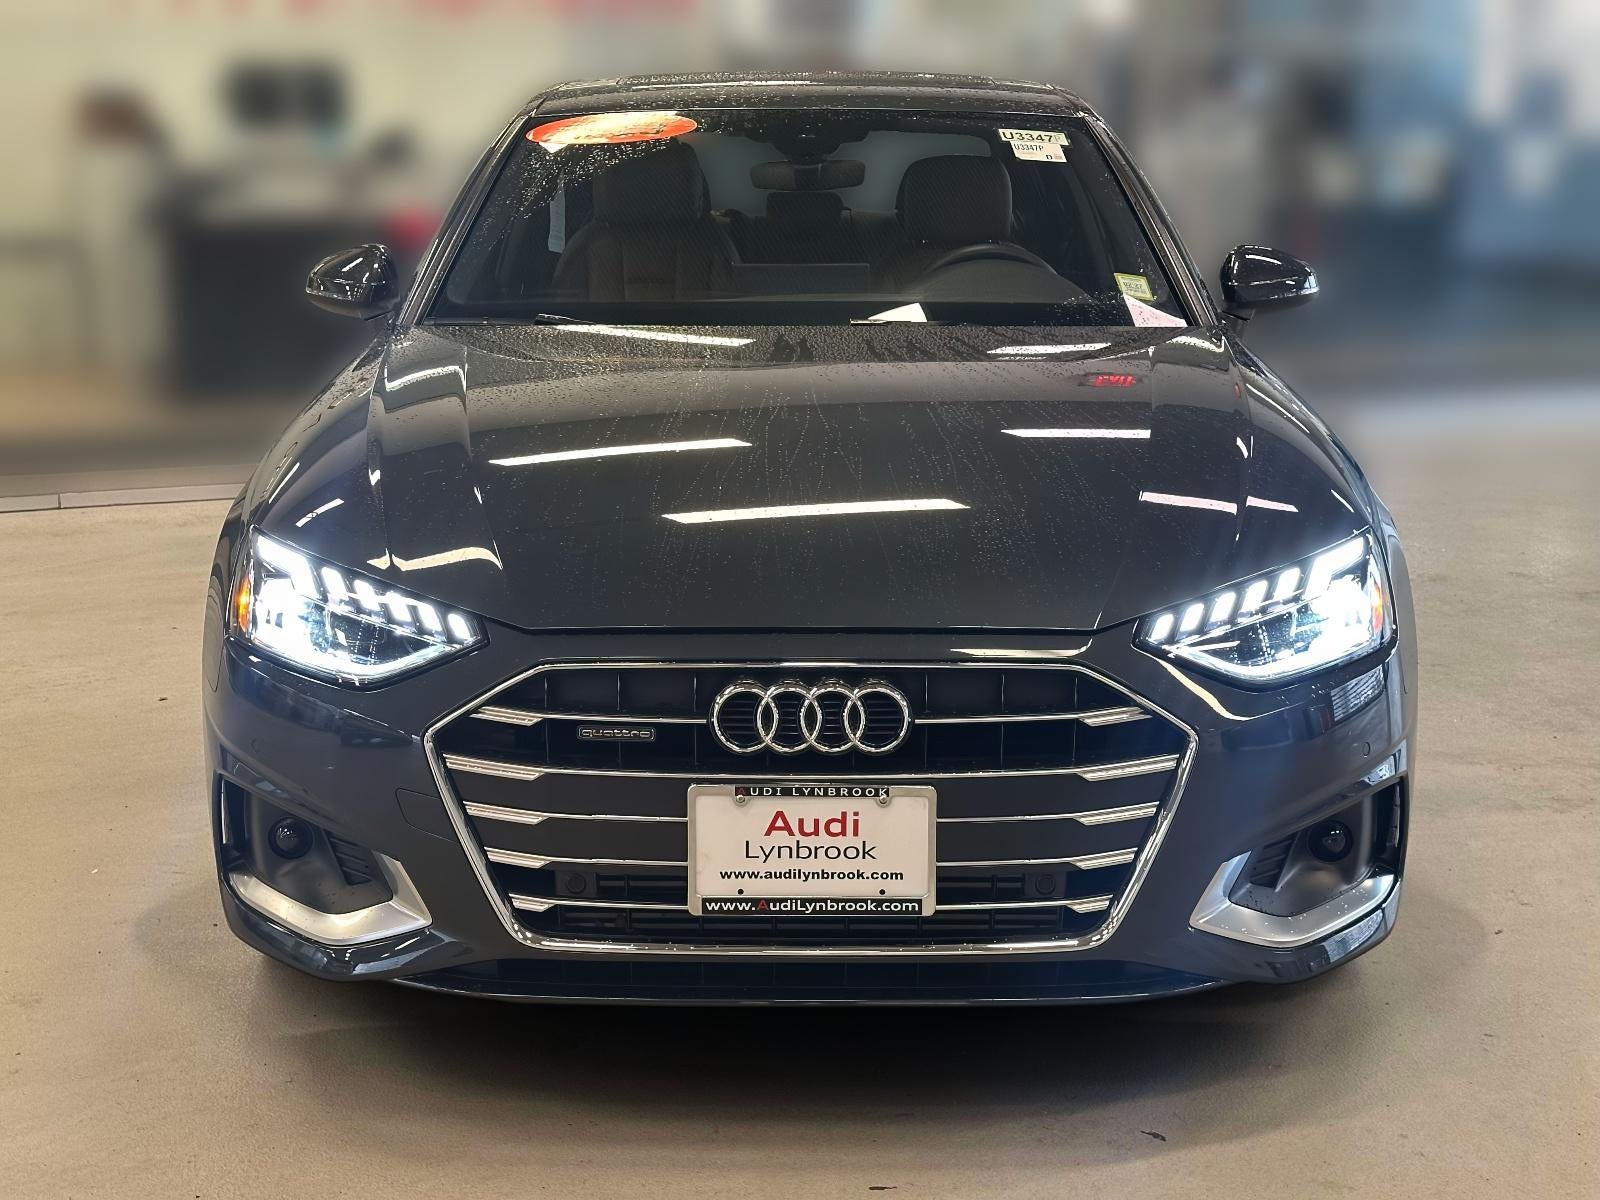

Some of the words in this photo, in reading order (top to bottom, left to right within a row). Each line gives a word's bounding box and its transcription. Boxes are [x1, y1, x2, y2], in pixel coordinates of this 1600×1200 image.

[581, 728, 651, 738] quattro
[737, 786, 783, 797] AUDI
[792, 786, 888, 797] LYNBROOK
[763, 810, 861, 838] Audi
[745, 840, 878, 864] Lynbrook
[719, 868, 905, 883] www.audilynbrook.com
[705, 898, 920, 914] www.AudiLynbrook.com
